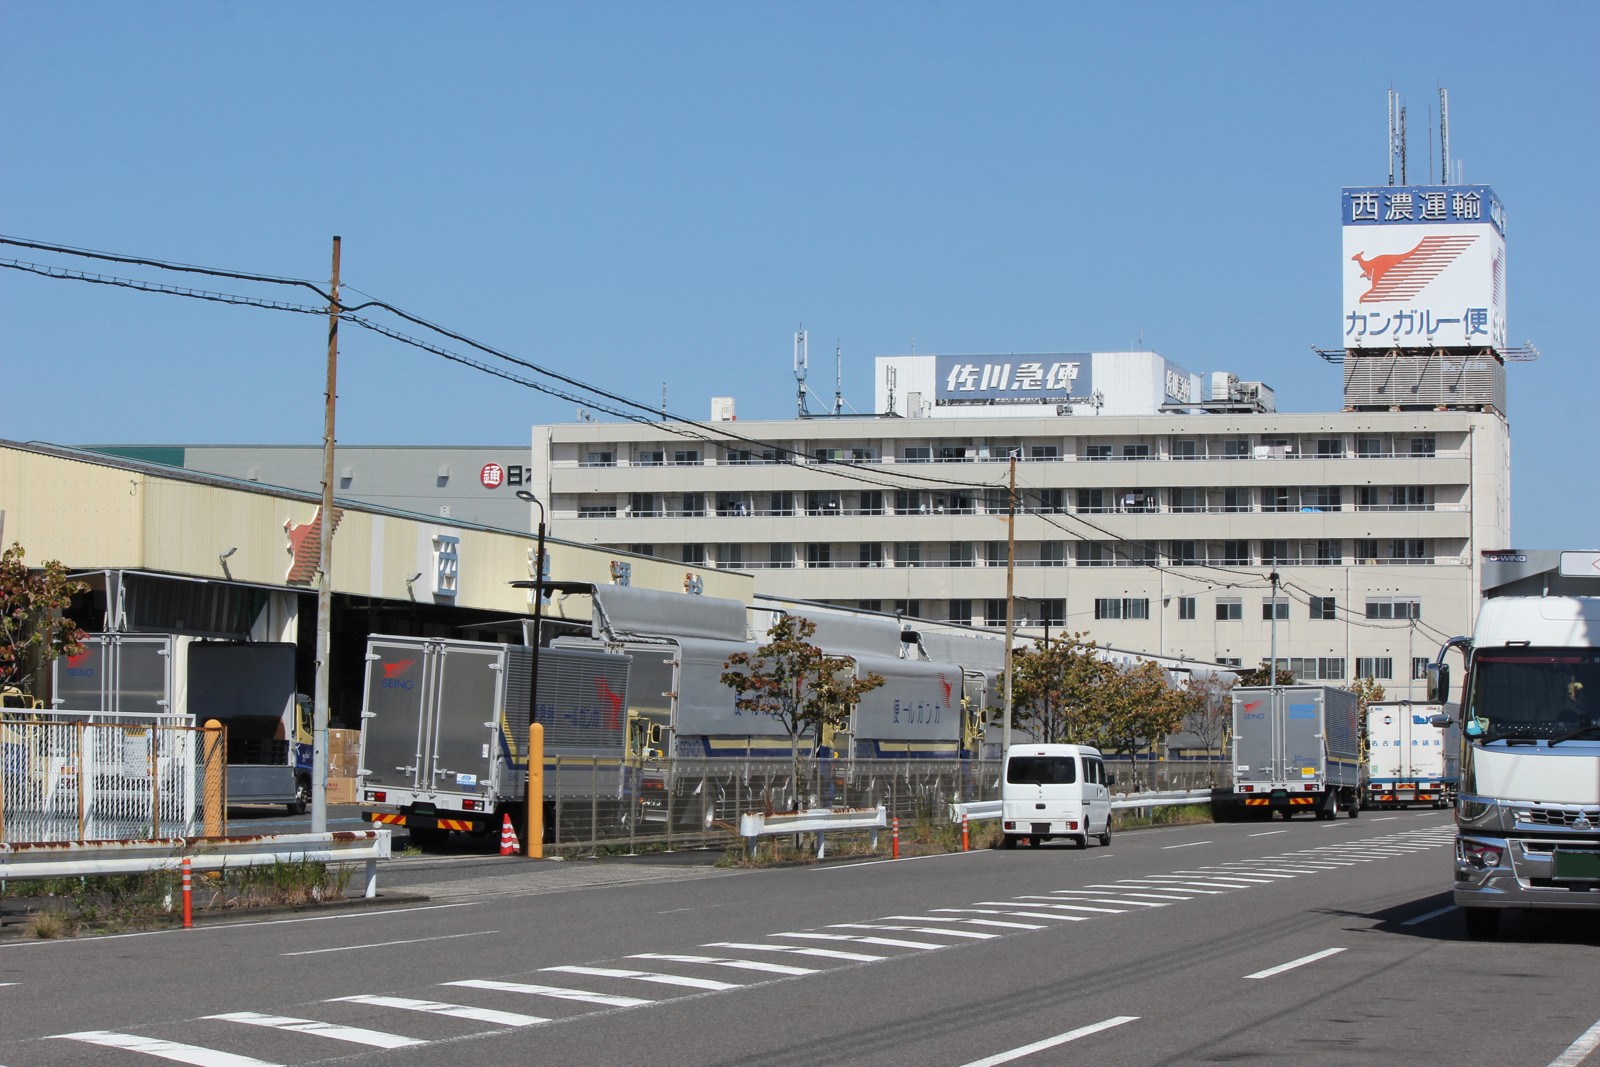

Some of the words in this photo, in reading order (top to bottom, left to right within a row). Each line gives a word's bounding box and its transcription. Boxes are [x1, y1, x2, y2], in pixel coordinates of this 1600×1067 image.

[1350, 190, 1482, 222] 西濃運輸
[1345, 307, 1489, 336] カンガルー便
[946, 361, 1080, 393] 佐川急便
[66, 668, 95, 678] SEINO
[381, 678, 415, 690] SEINO
